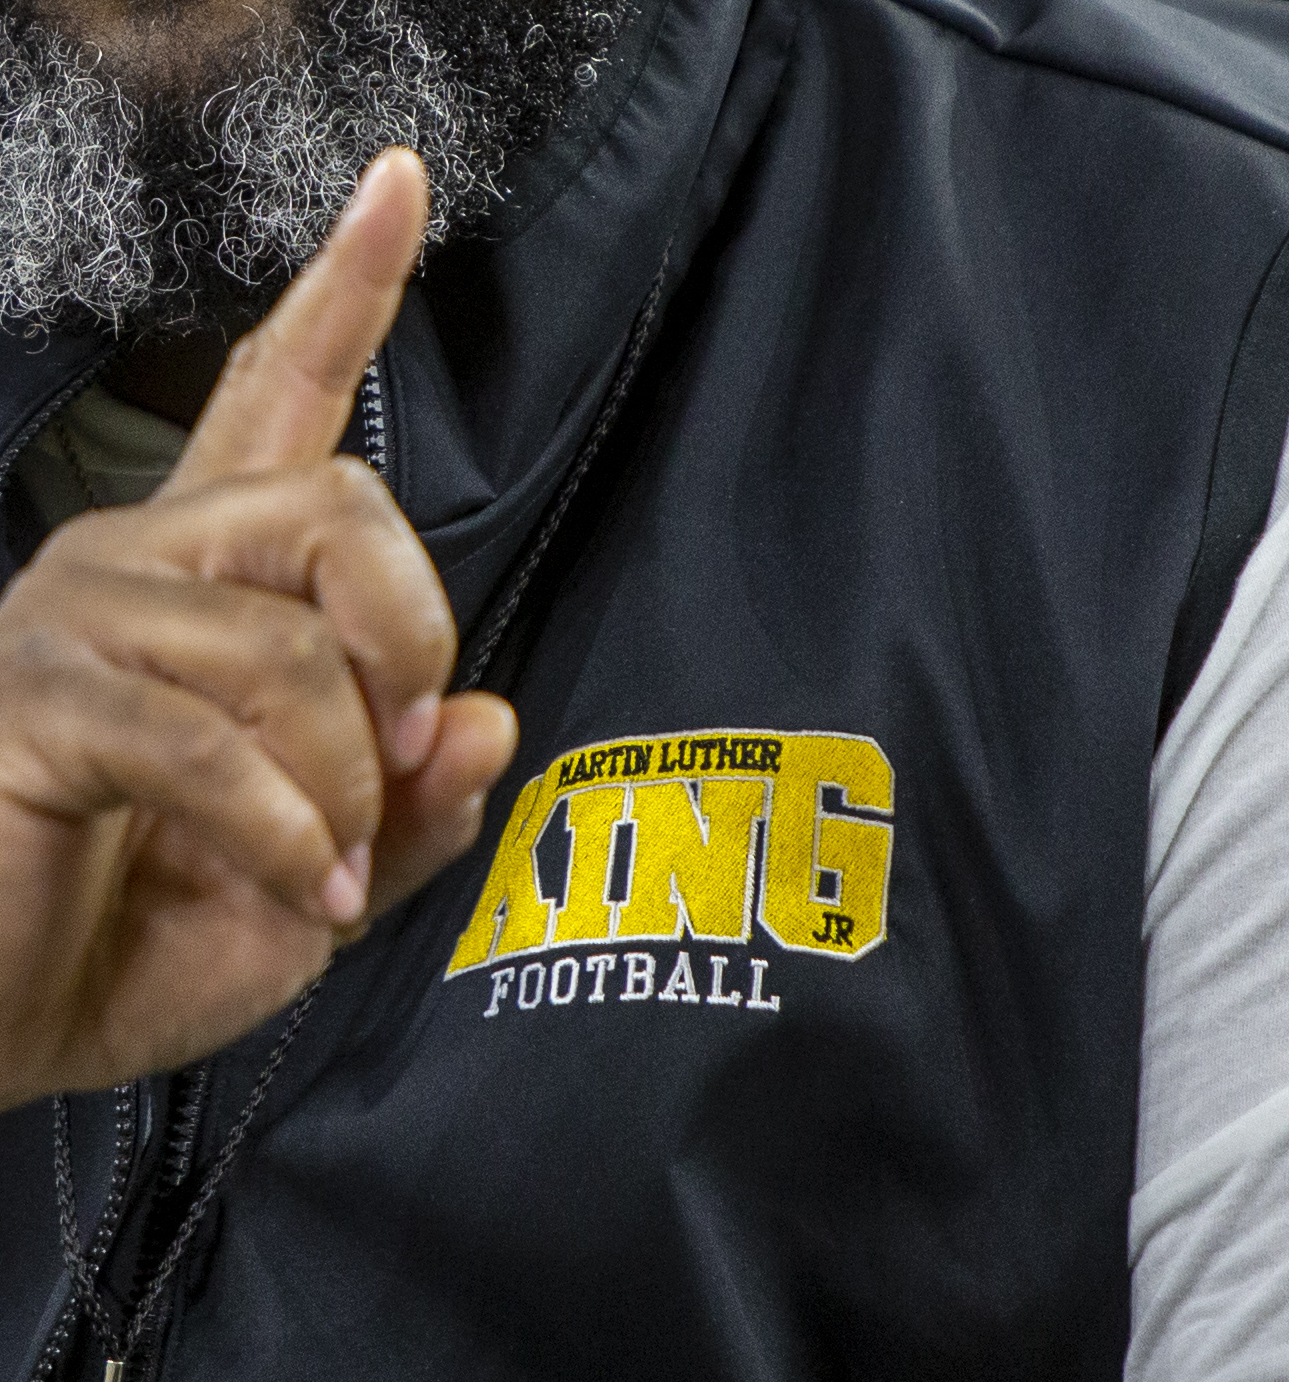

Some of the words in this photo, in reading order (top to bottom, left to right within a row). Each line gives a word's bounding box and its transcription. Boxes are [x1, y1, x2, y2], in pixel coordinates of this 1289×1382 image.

[555, 740, 653, 790] MARTIN
[659, 737, 783, 774] LUTHER
[444, 728, 896, 981] KING
[811, 910, 855, 947] JR
[483, 951, 781, 1018] FOOTBALL
